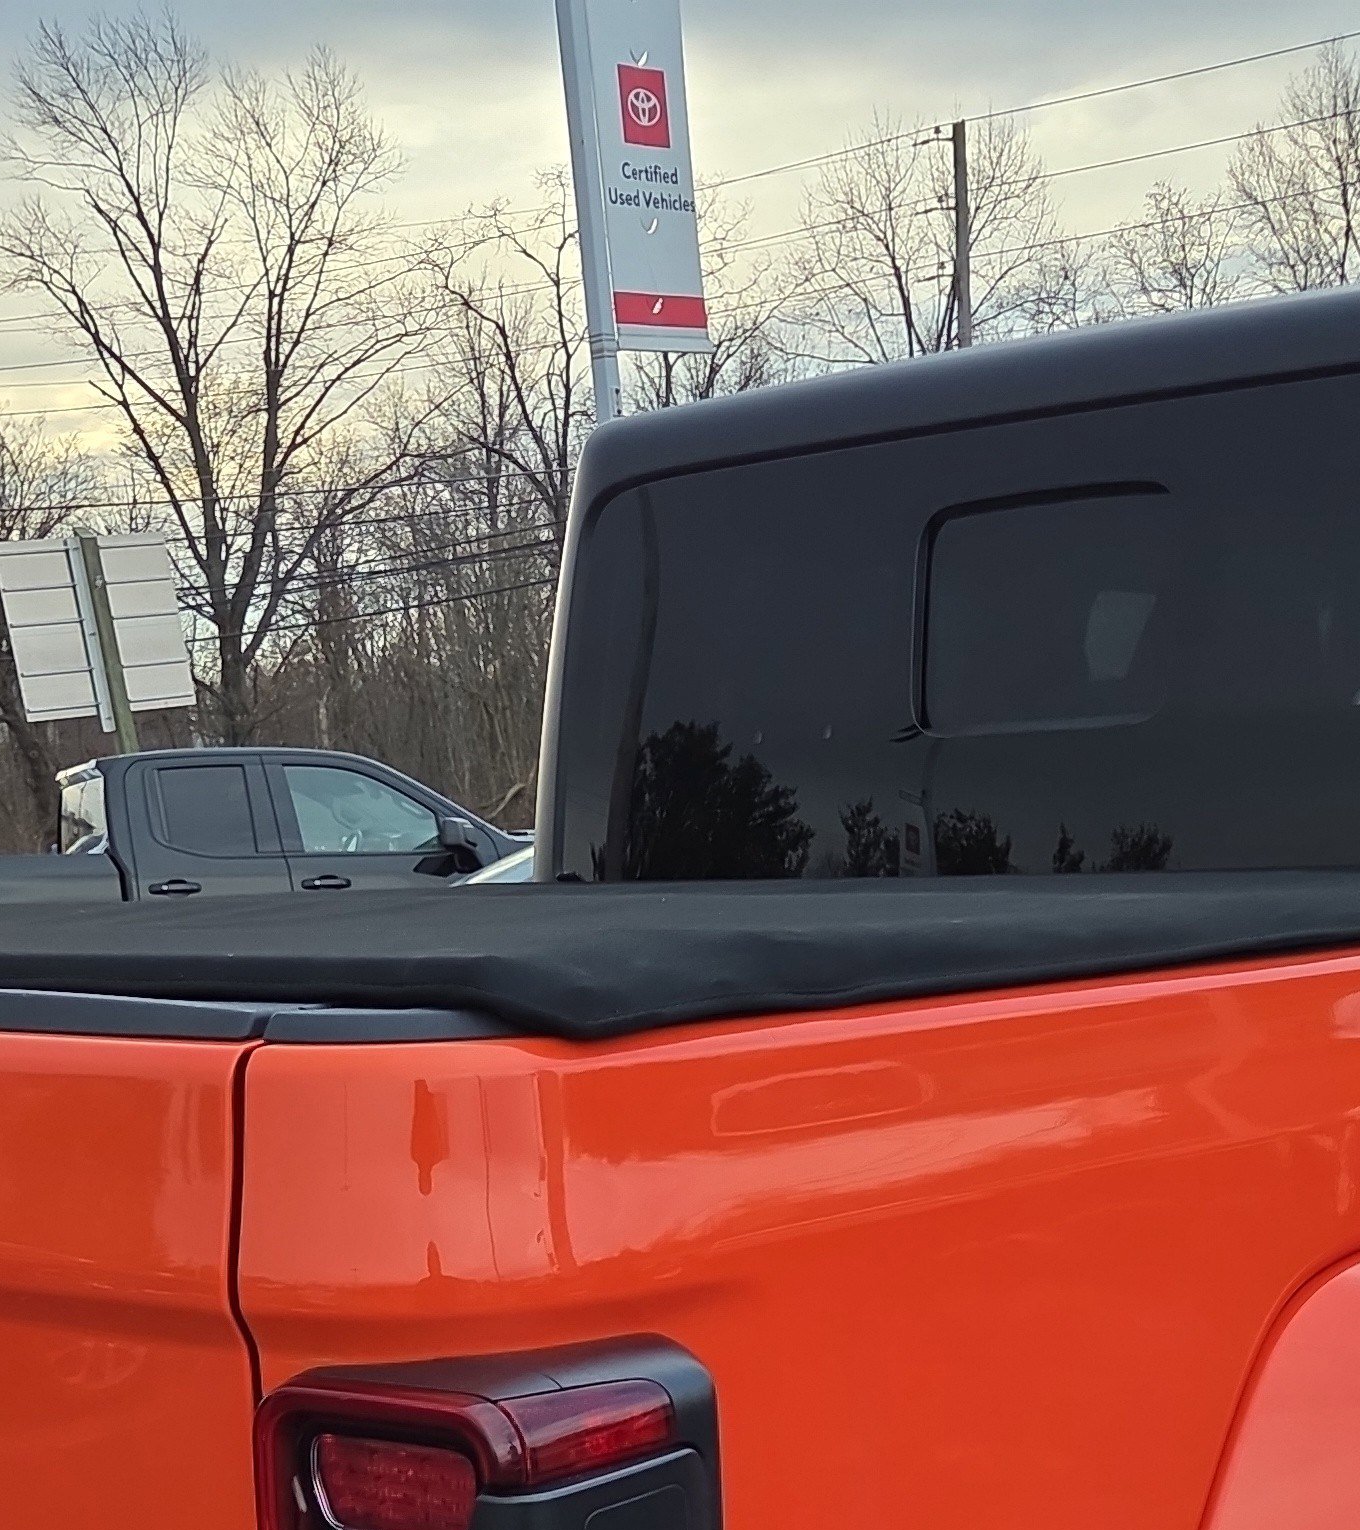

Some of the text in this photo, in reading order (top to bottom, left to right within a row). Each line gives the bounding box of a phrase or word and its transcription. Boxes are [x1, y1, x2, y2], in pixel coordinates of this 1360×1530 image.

[621, 161, 678, 184] Certified
[608, 187, 695, 213] Used Vehicles
